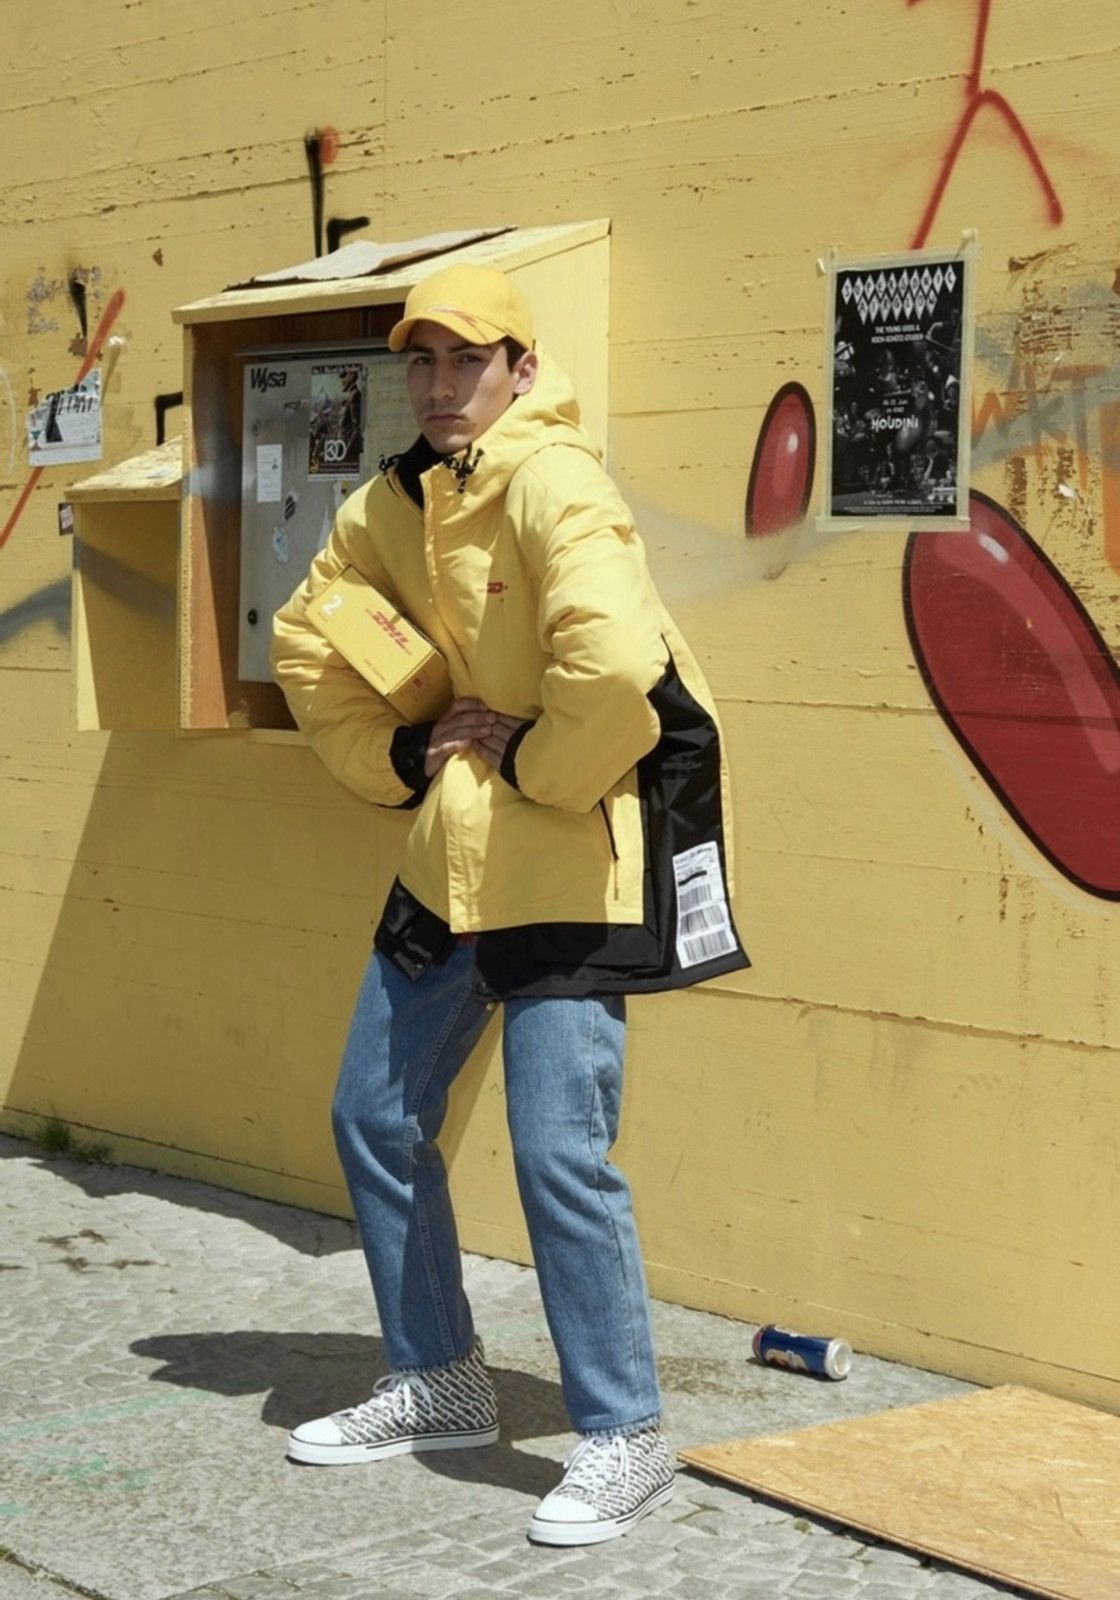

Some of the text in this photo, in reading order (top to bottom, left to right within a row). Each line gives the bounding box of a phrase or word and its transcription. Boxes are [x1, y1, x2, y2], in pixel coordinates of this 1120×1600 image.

[871, 414, 919, 432] HOUDINI
[322, 593, 343, 616] 2
[371, 610, 409, 650] DHL
